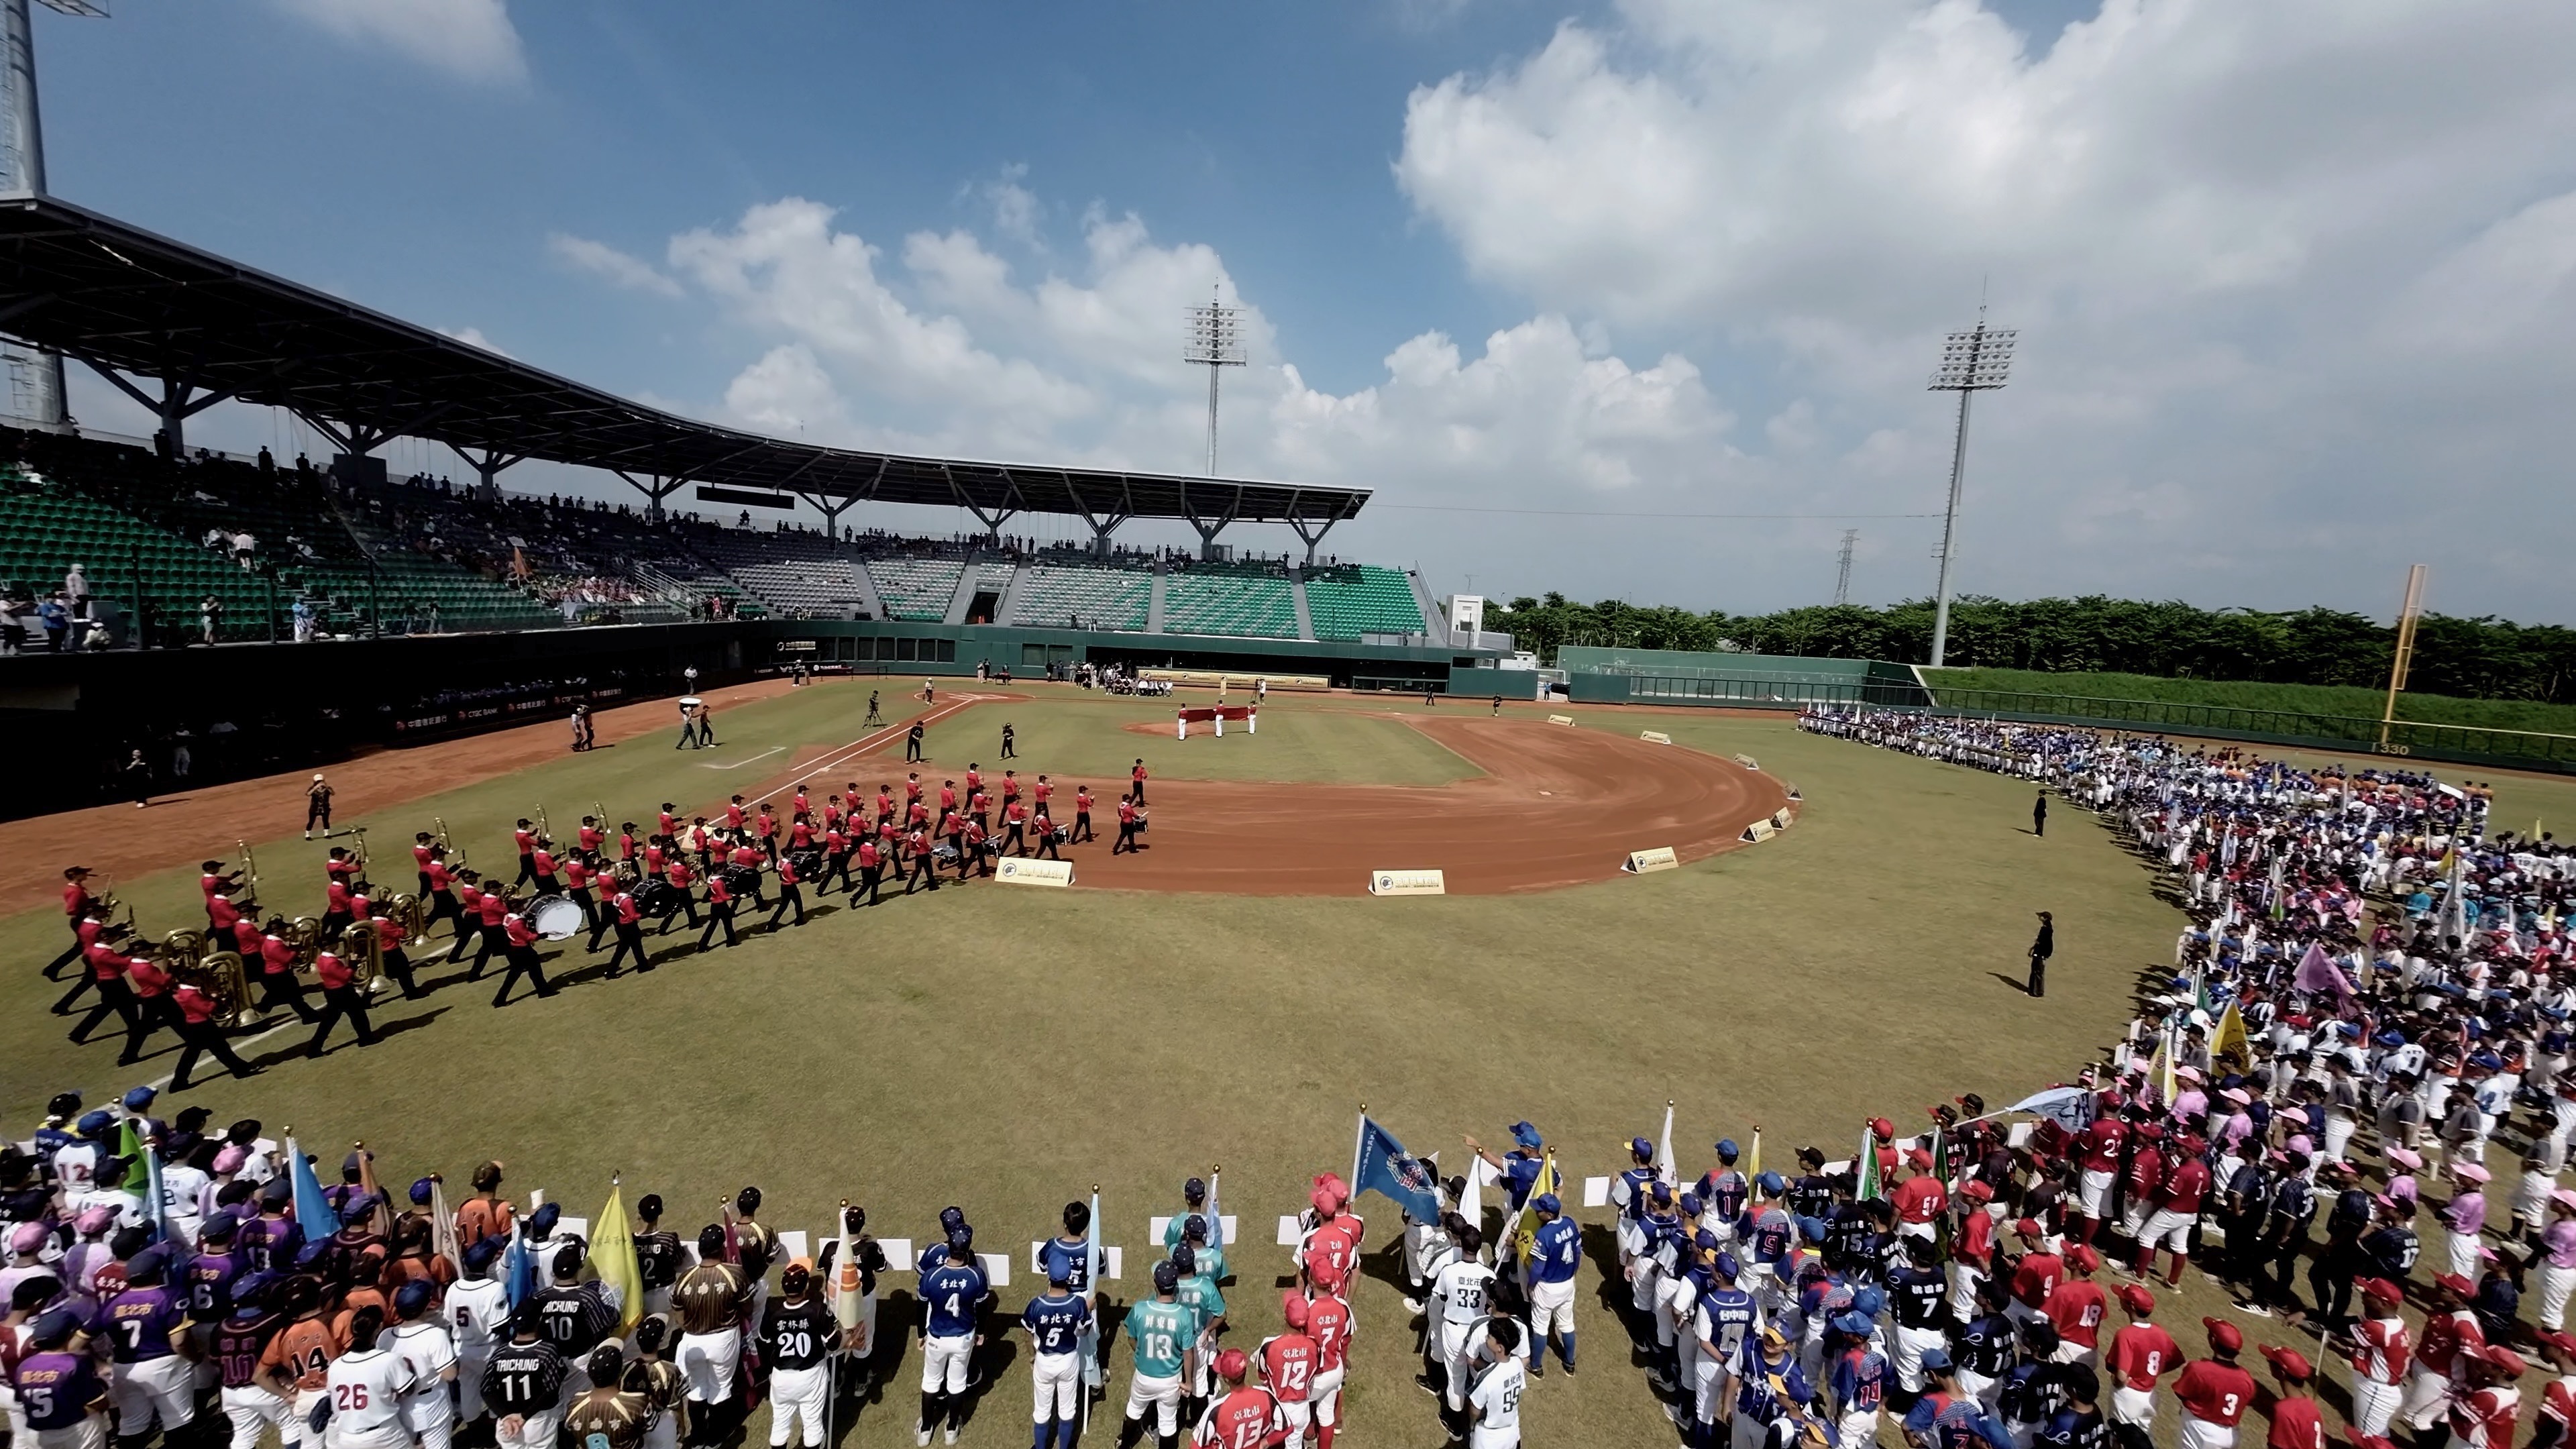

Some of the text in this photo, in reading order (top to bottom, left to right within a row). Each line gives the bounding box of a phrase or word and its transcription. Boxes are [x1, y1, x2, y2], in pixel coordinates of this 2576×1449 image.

[2380, 744, 2409, 755] 330
[58, 1161, 93, 1182] 12
[1762, 1234, 1778, 1255] 9
[644, 1257, 656, 1280] 2
[194, 1284, 213, 1309] 6
[1457, 1288, 1481, 1308] 33
[2043, 1275, 2053, 1297] 9
[455, 1305, 469, 1327] 5
[945, 1293, 960, 1318] 4
[1922, 1297, 1938, 1318] 7
[2079, 1305, 2102, 1328] 18
[545, 1316, 573, 1341] 10
[1040, 1313, 1073, 1324] 新北市
[121, 1319, 142, 1349] 7
[777, 1332, 812, 1358] 20
[1145, 1332, 1173, 1360] 13
[1321, 1326, 1336, 1353] 7
[290, 1344, 331, 1379] 14
[496, 1358, 539, 1373] TAICHUNG
[2147, 1350, 2161, 1377] 8
[501, 1374, 531, 1402] 11
[1281, 1360, 1309, 1391] 12
[335, 1383, 368, 1411] 26
[2222, 1393, 2239, 1417] 3
[1234, 1417, 1264, 1449] 13
